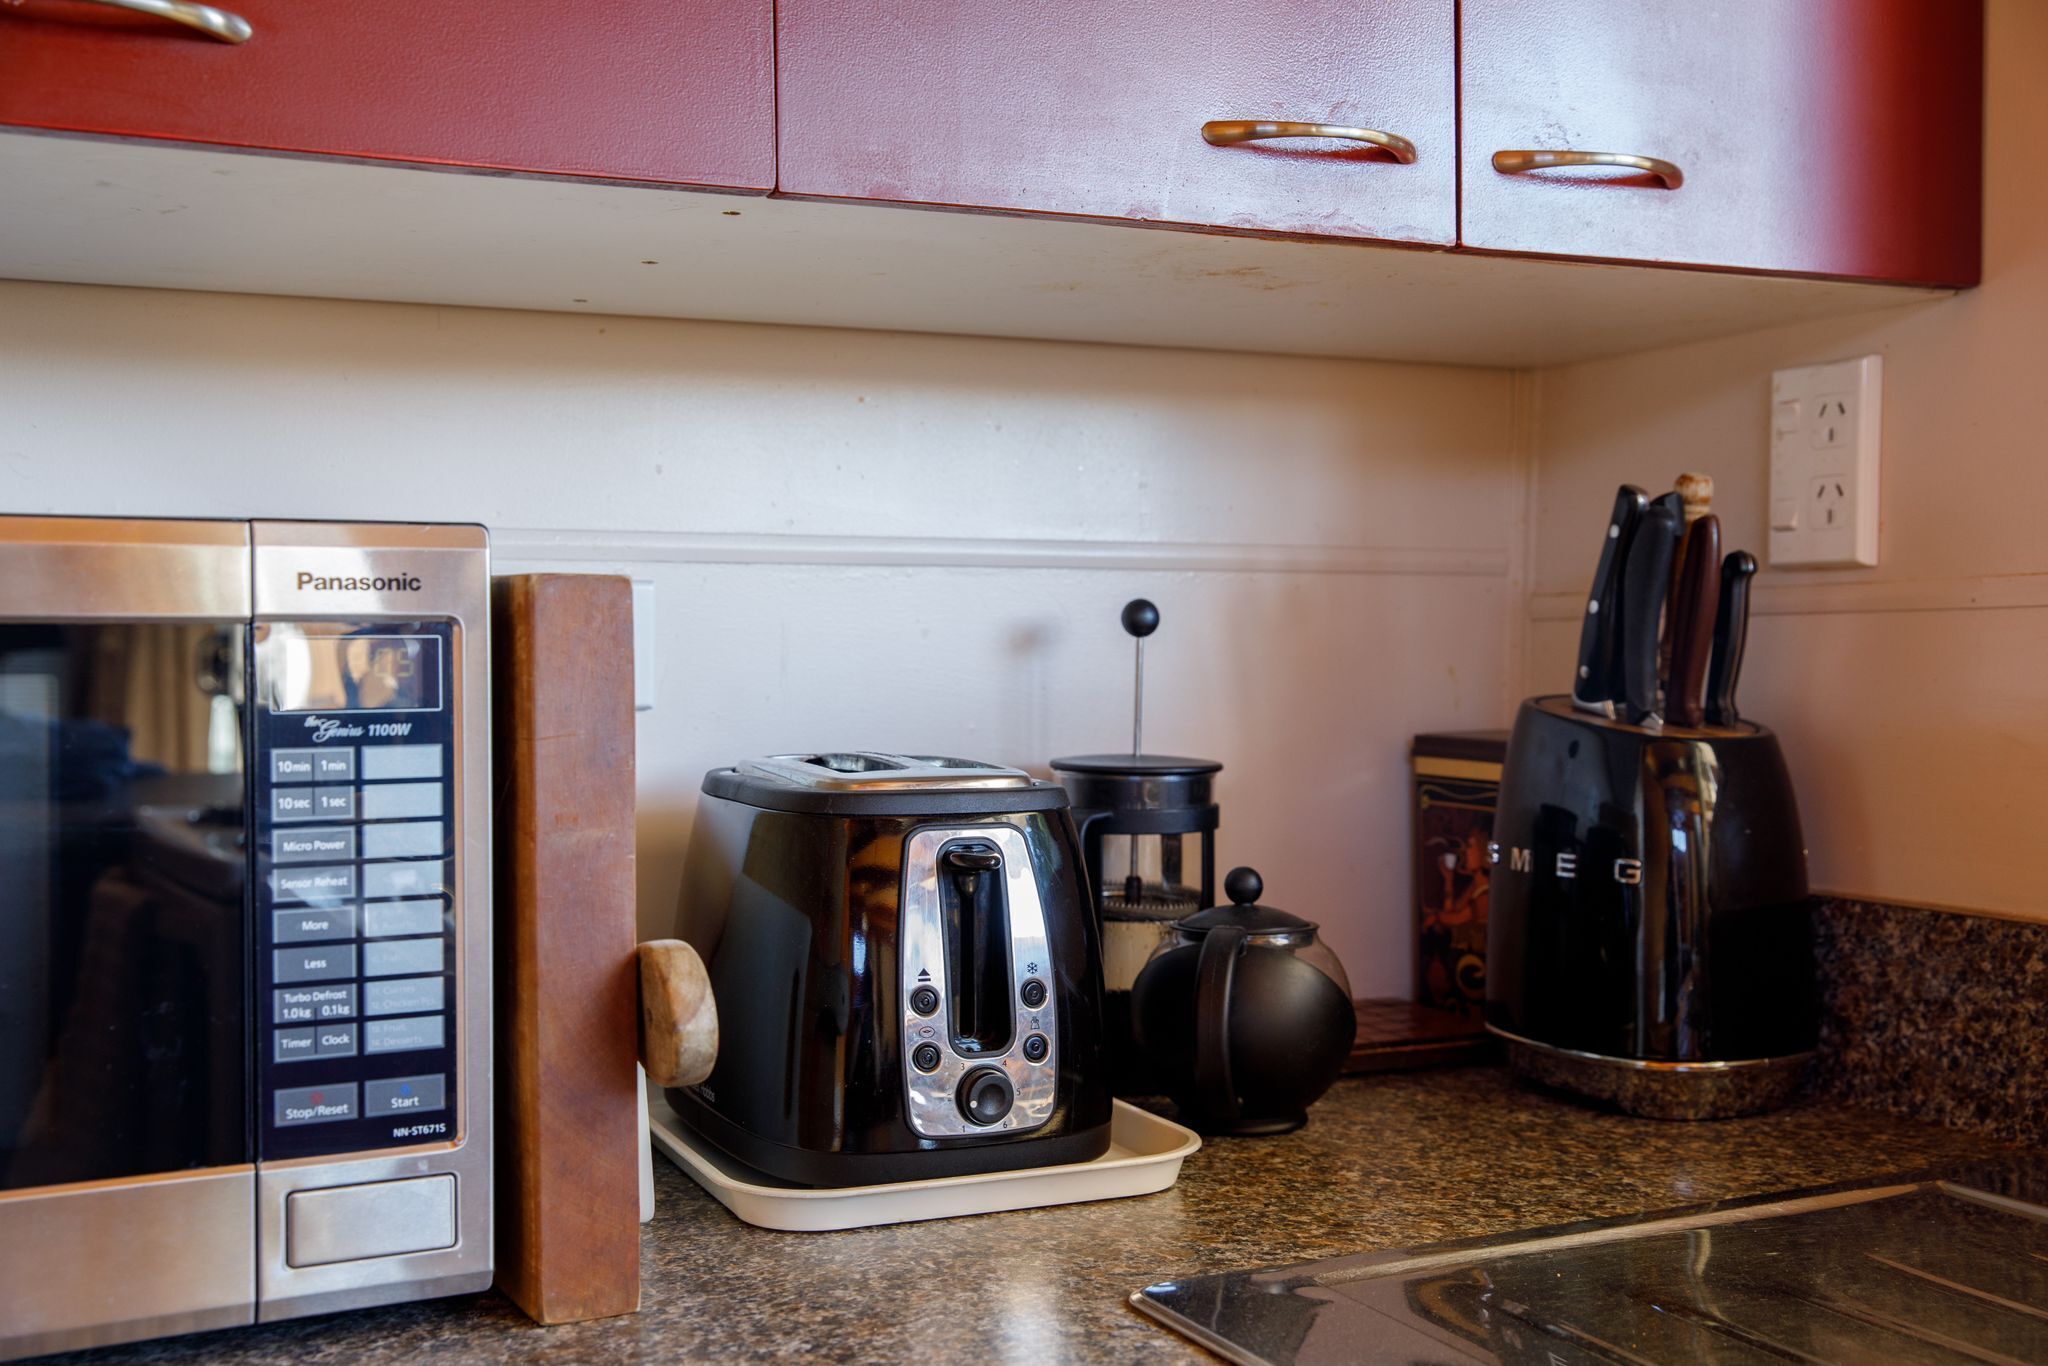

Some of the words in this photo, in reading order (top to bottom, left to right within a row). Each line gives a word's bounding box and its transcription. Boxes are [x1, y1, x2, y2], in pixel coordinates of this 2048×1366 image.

[297, 572, 421, 592] Panasonic
[312, 719, 365, 743] Genius
[368, 723, 412, 737] 1100W
[283, 841, 313, 852] Micro
[314, 840, 345, 850] Power
[281, 879, 312, 890] Sensor
[314, 877, 348, 887] Reheat
[302, 920, 329, 931] More
[304, 958, 327, 969] Less
[283, 993, 311, 1003] Turbo
[312, 990, 347, 1001] Defrost
[281, 1038, 312, 1049] Timer
[321, 1033, 350, 1046] Clock
[961, 1062, 966, 1071] 3
[1002, 1059, 1008, 1068] 4
[391, 1096, 419, 1107] Start
[286, 1104, 348, 1120] Stop/Reset
[393, 1123, 446, 1138] NN-ST671S
[1002, 1120, 1008, 1129] 6
